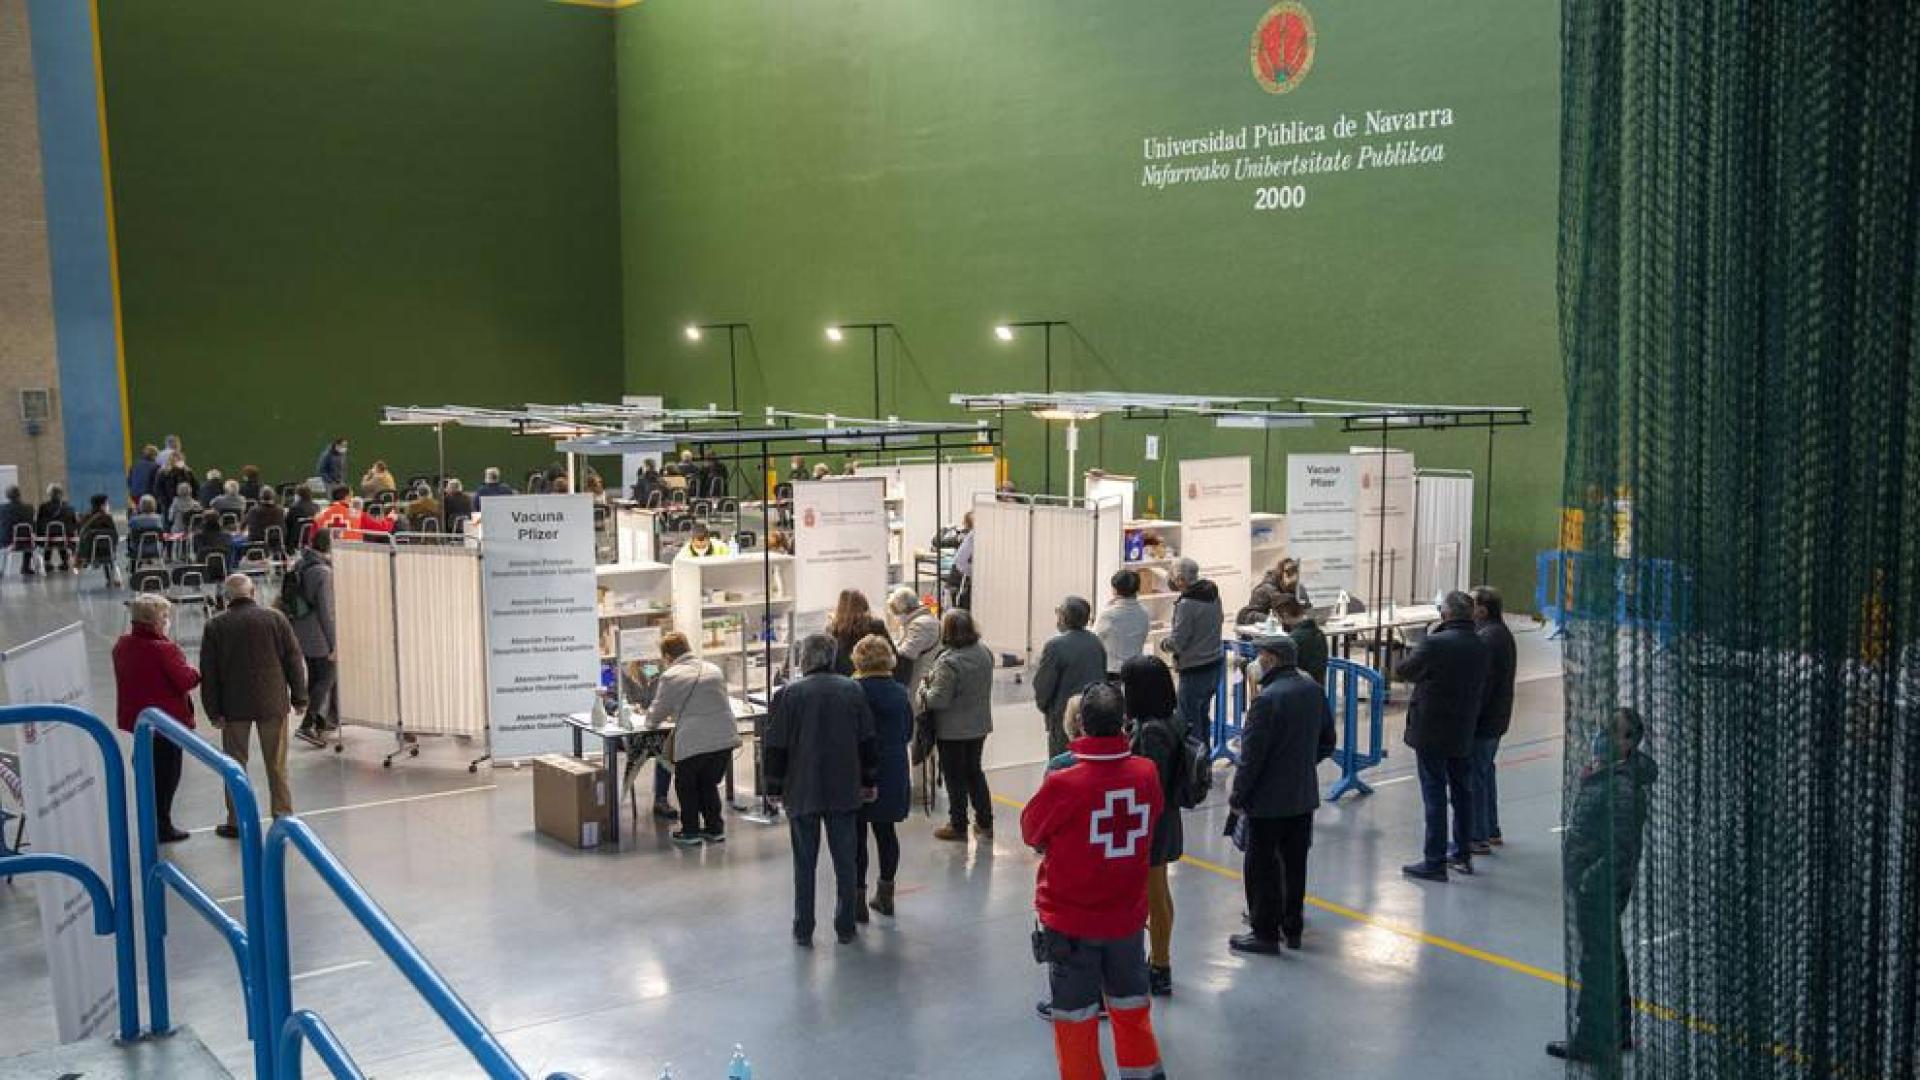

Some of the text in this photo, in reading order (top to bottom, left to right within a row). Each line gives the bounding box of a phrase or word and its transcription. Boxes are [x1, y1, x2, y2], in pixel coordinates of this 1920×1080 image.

[1143, 107, 1454, 159] Universidad Pública de Navarra
[1142, 141, 1445, 188] Nafarroako Unibertsitate Publikoa
[1254, 185, 1306, 210] 2000
[511, 511, 564, 523] Vacuna
[517, 528, 559, 540] Pfizer
